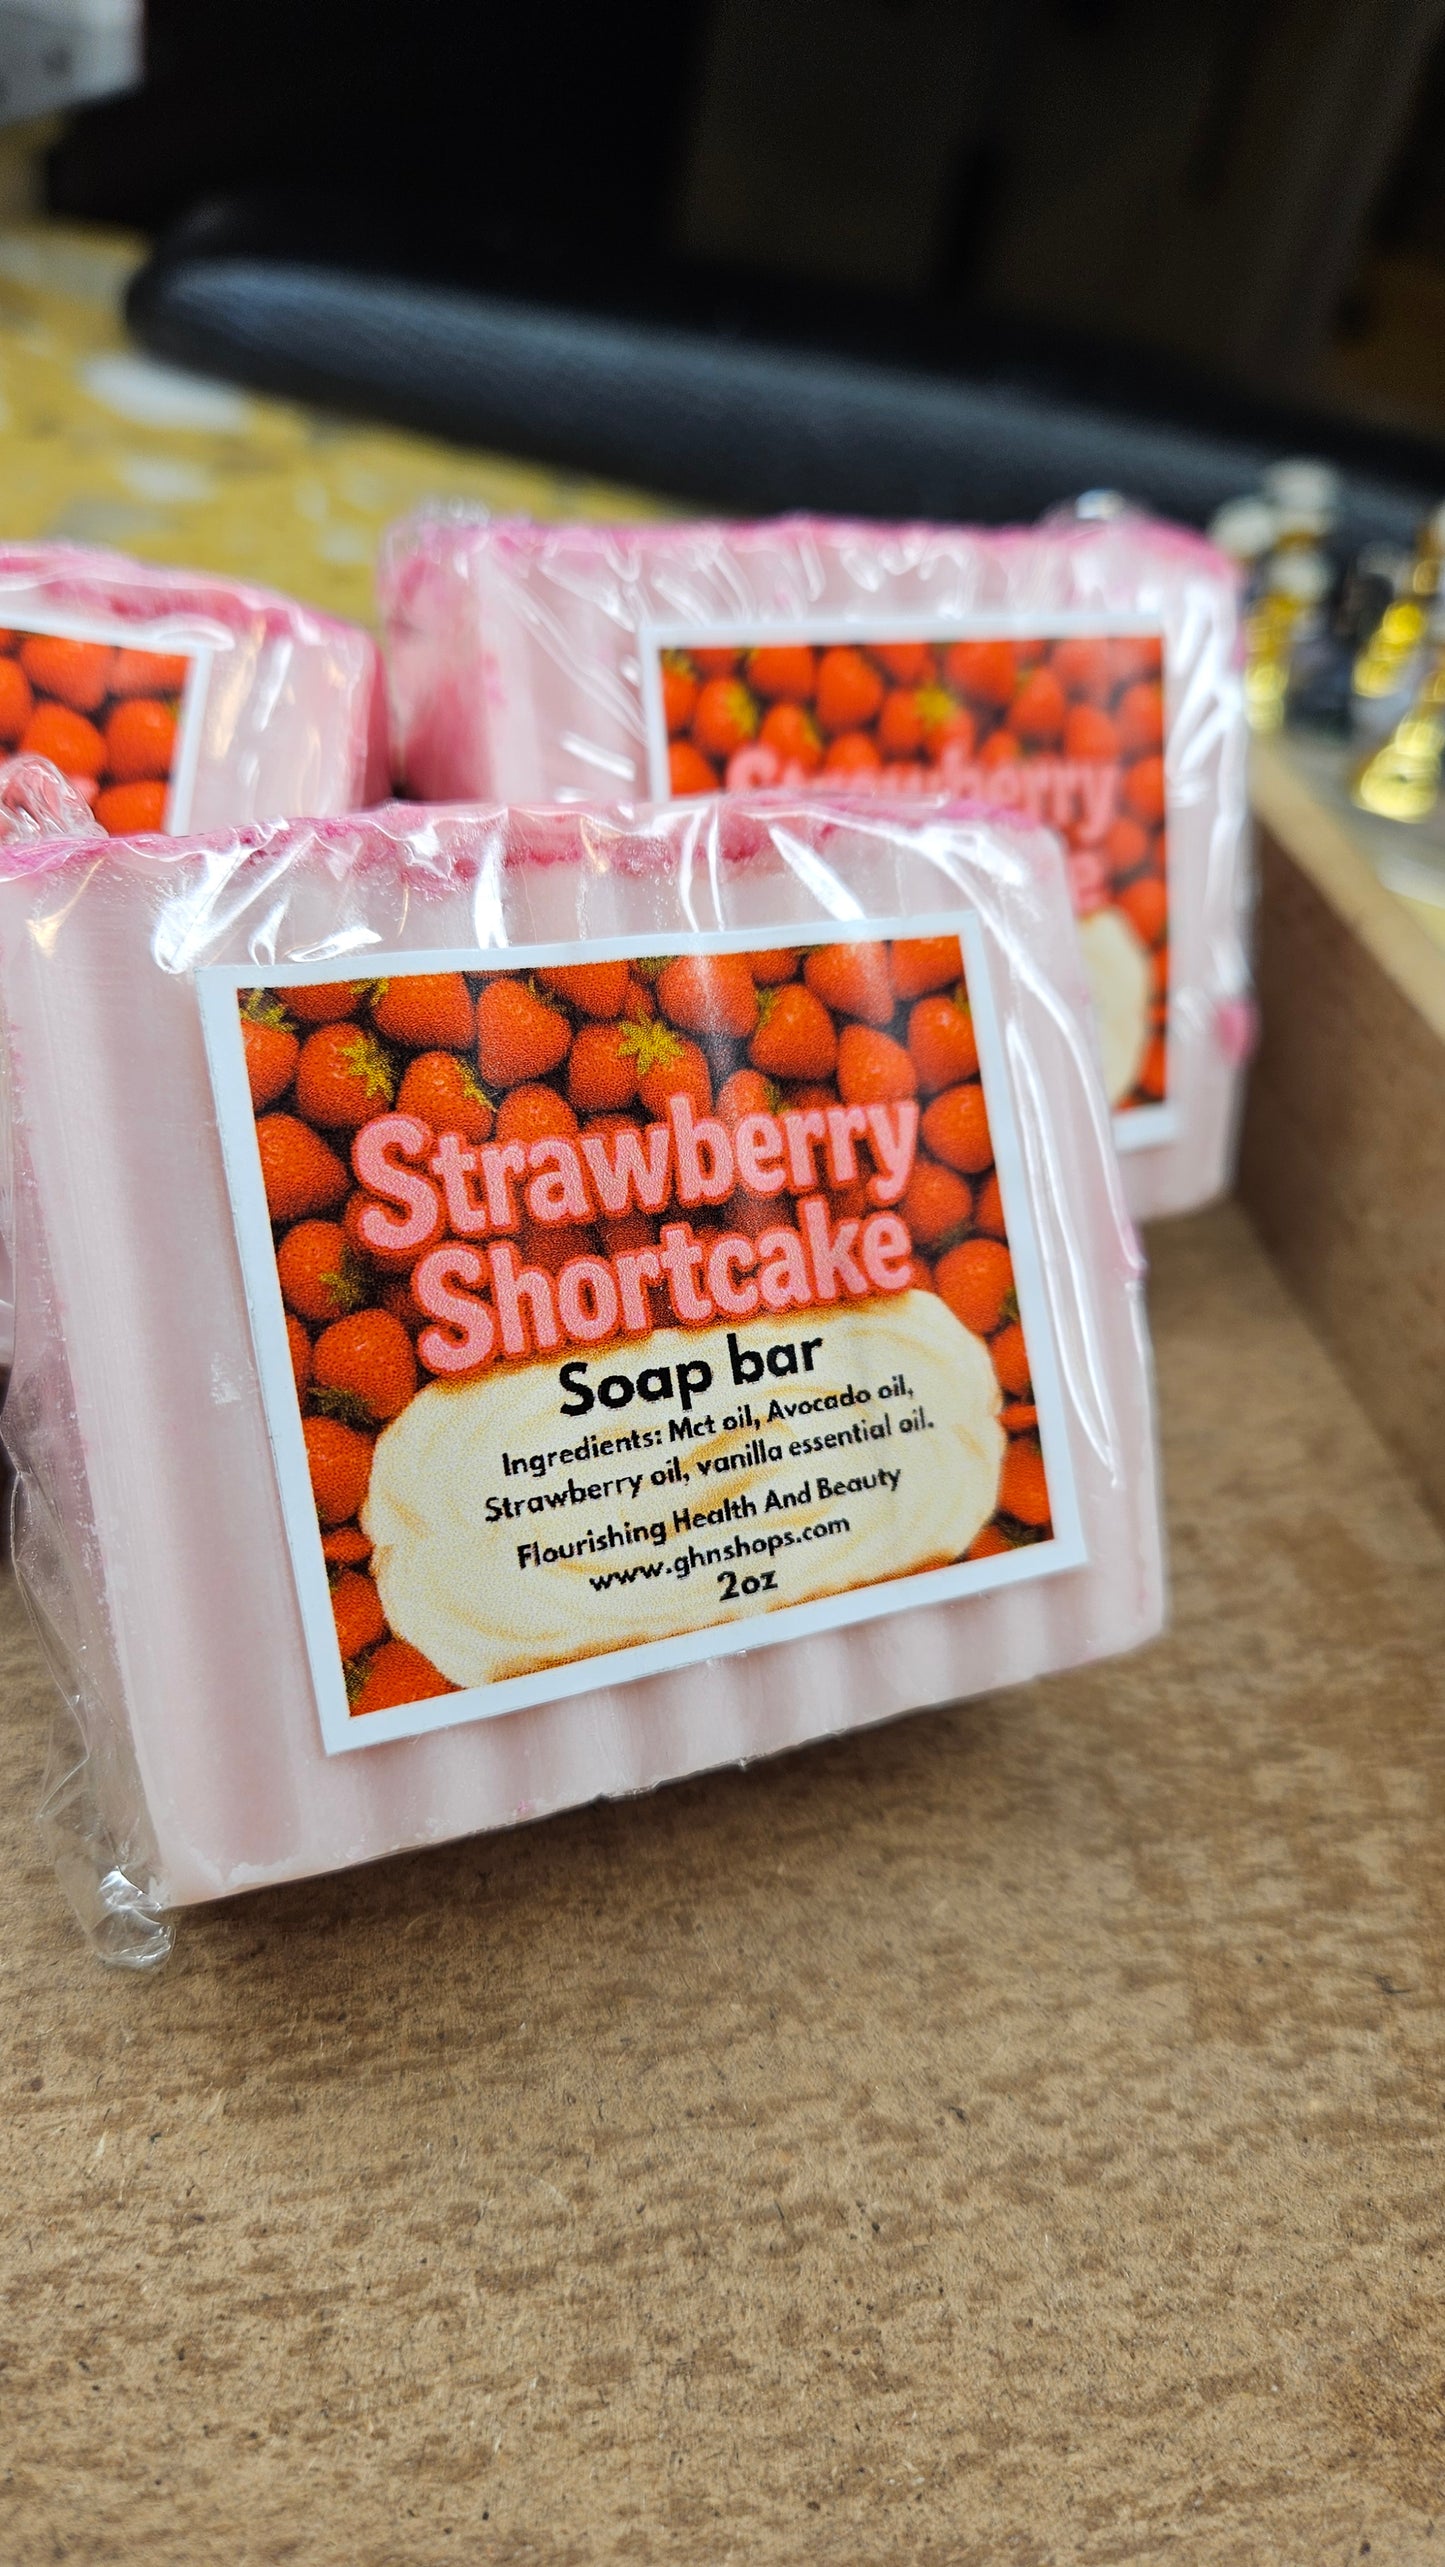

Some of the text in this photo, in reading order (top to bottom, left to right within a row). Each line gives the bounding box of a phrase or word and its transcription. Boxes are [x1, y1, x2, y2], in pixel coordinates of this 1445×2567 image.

[353, 1097, 919, 1250] Strawberry
[417, 1199, 912, 1372] Shortcake
[502, 1374, 914, 1478] Ingredients: Mct oil, Avocado oil,
[559, 1332, 824, 1417] Soap bar
[484, 1406, 935, 1523] Strawberry oil, vanilla essential oil.
[516, 1467, 902, 1570] Flourishing Health And Beauty
[588, 1516, 851, 1593] www.ghnshops.com
[716, 1569, 779, 1602] 2oz
